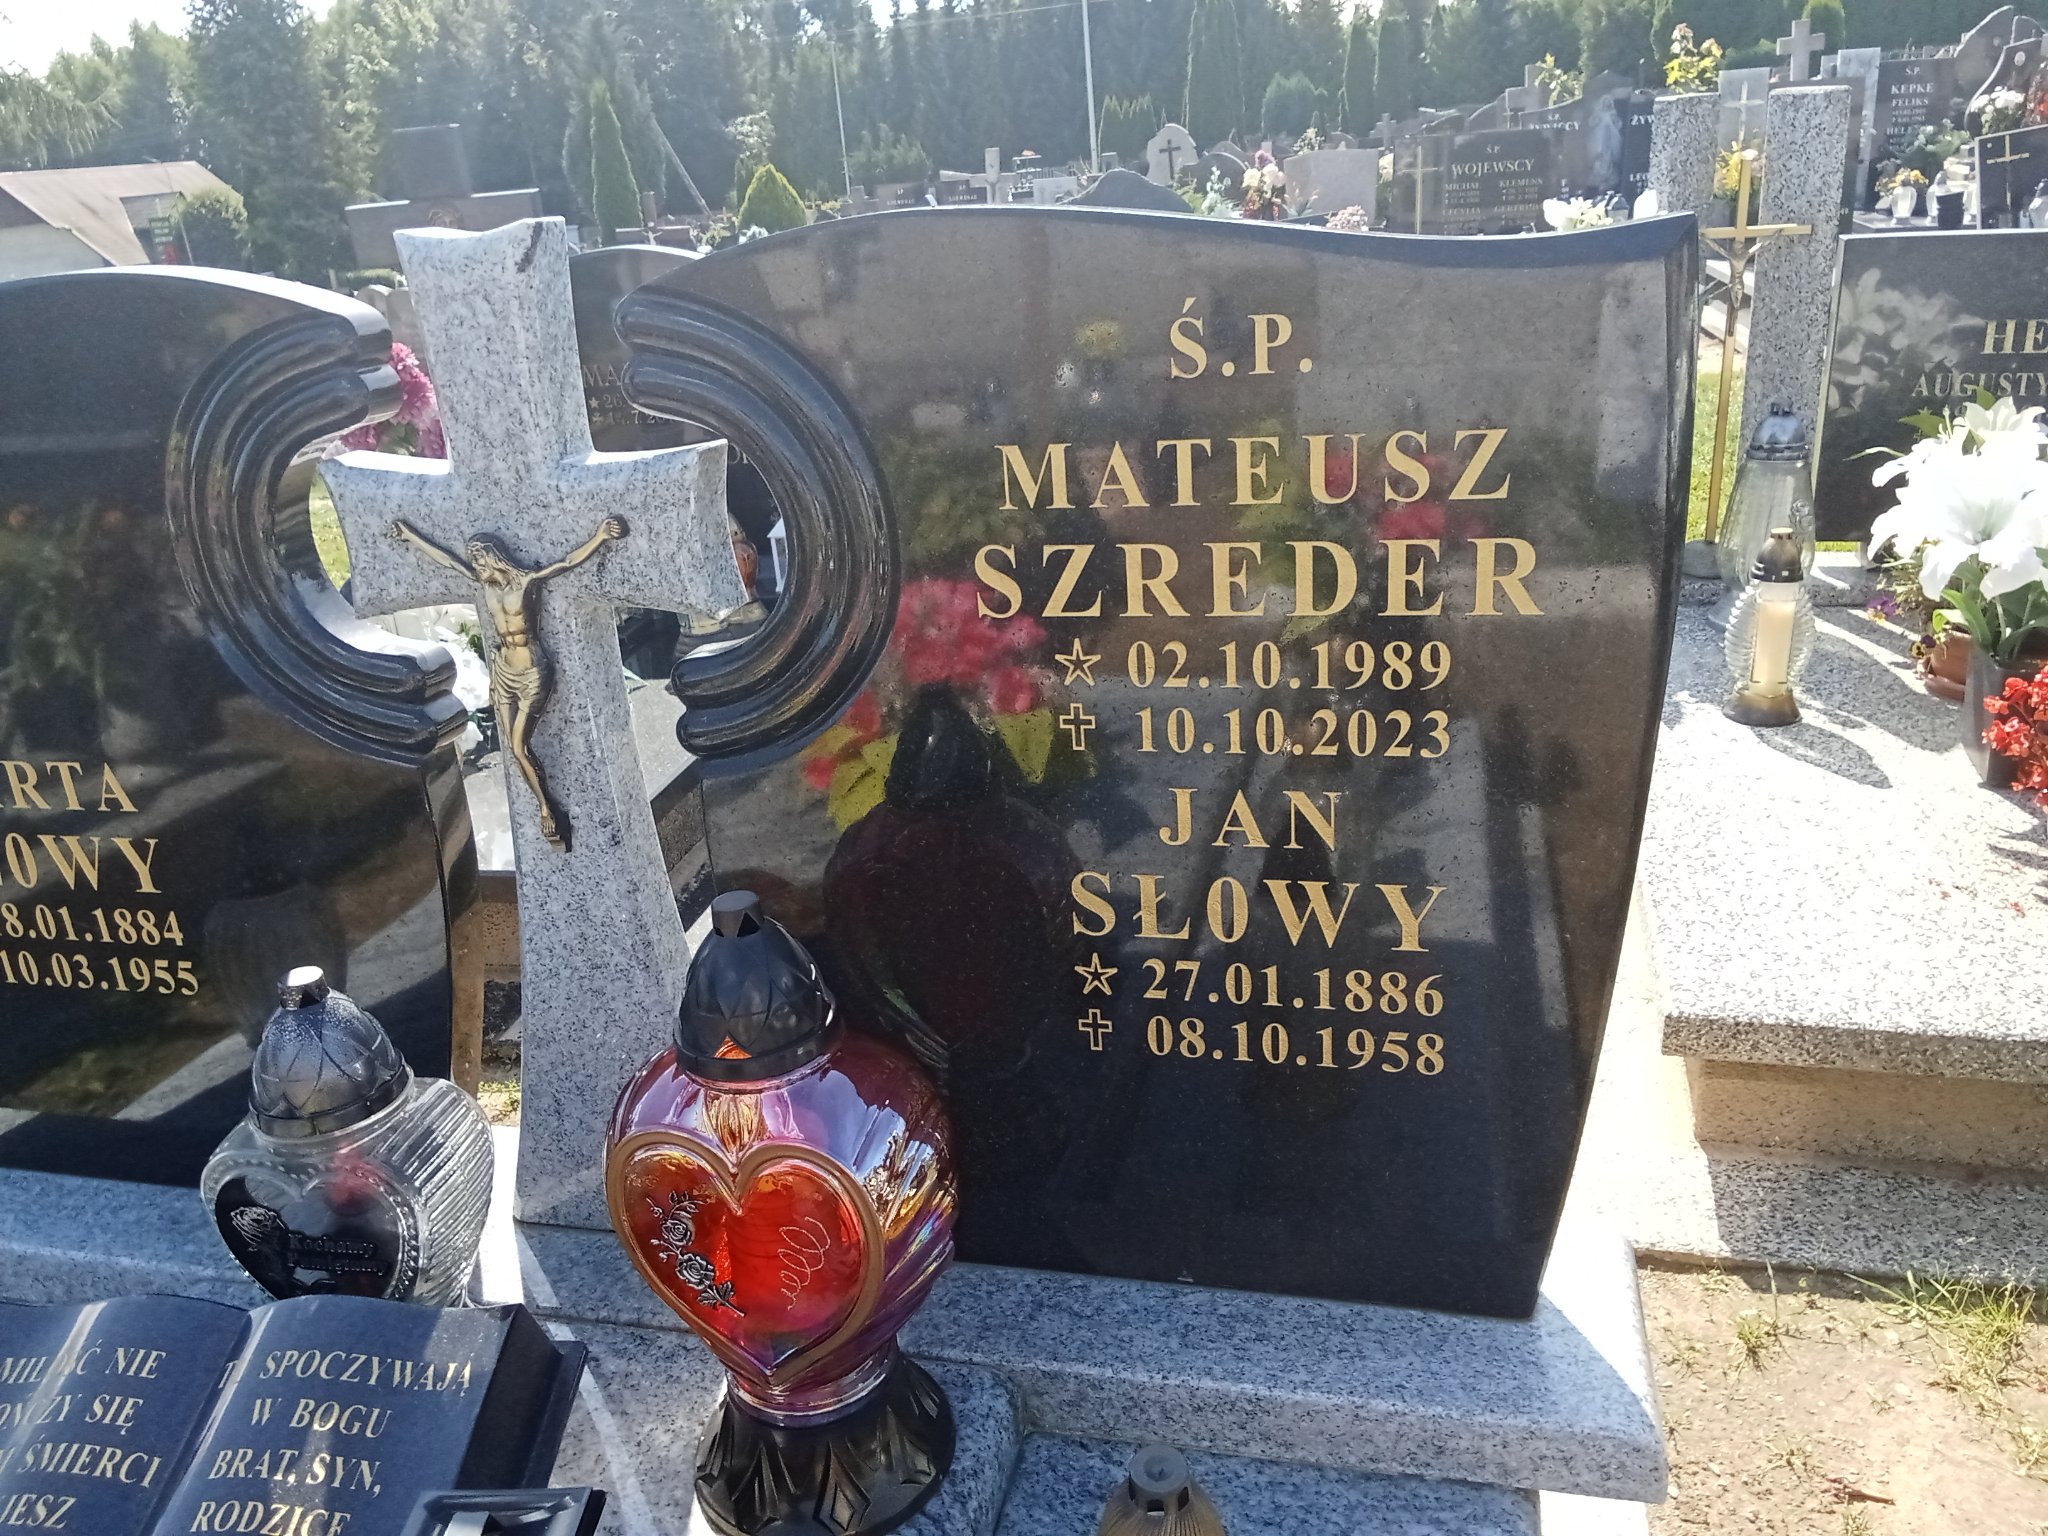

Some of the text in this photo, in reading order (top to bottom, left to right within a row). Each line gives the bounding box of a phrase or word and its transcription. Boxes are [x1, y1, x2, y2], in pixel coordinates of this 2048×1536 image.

[1891, 83, 1934, 95] KEPKE
[1892, 98, 1929, 107] FELIKS
[1451, 159, 1535, 178] WOJEWSCY
[994, 427, 1511, 511] MATEUSZ
[974, 536, 1545, 619] SZREDER
[1127, 640, 1452, 691] 02.10.1989
[1134, 706, 1452, 759] 10.10.2023
[0, 760, 138, 812] RTA
[1158, 788, 1342, 851] JAN
[0, 832, 161, 893] OWY
[0, 902, 184, 946] 8.01.1884
[1142, 958, 1445, 1017] 27.01.1886
[1147, 1015, 1445, 1076] 08.10.1958
[105, 1347, 167, 1379] NIE
[259, 1349, 472, 1397] SPOCZYWAJĄ
[85, 1394, 144, 1435] SIĘ
[252, 1398, 393, 1439] W BOGU
[17, 1434, 163, 1488] ŚMIERCI
[208, 1449, 382, 1498] BRAT, SYN,
